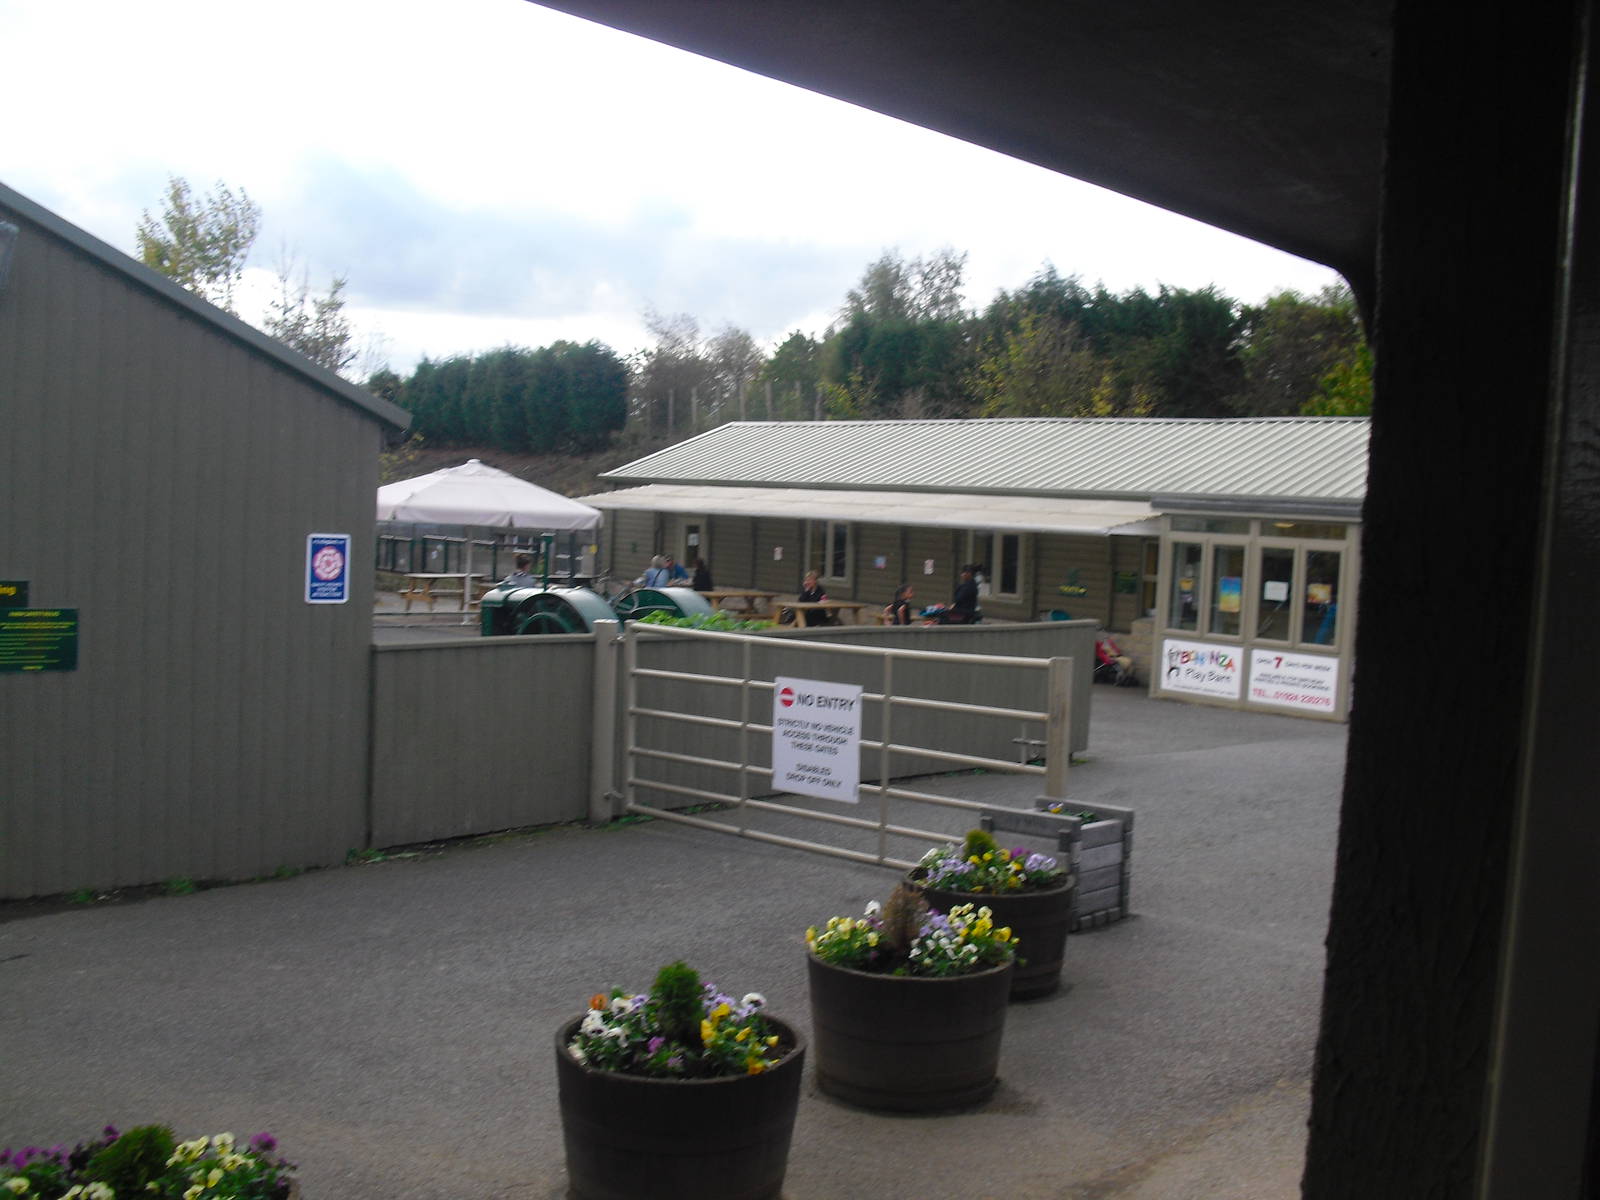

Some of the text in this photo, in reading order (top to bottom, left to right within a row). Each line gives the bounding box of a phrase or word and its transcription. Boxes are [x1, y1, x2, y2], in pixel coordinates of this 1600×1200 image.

[1274, 656, 1283, 669] 7
[798, 694, 855, 712] NO ENTRY
[778, 718, 855, 735] STRICTLY NO VEHICLE
[783, 730, 847, 744] ACCESS THROUGH
[791, 741, 838, 756] THESE GATES
[823, 779, 841, 788] ONLY
